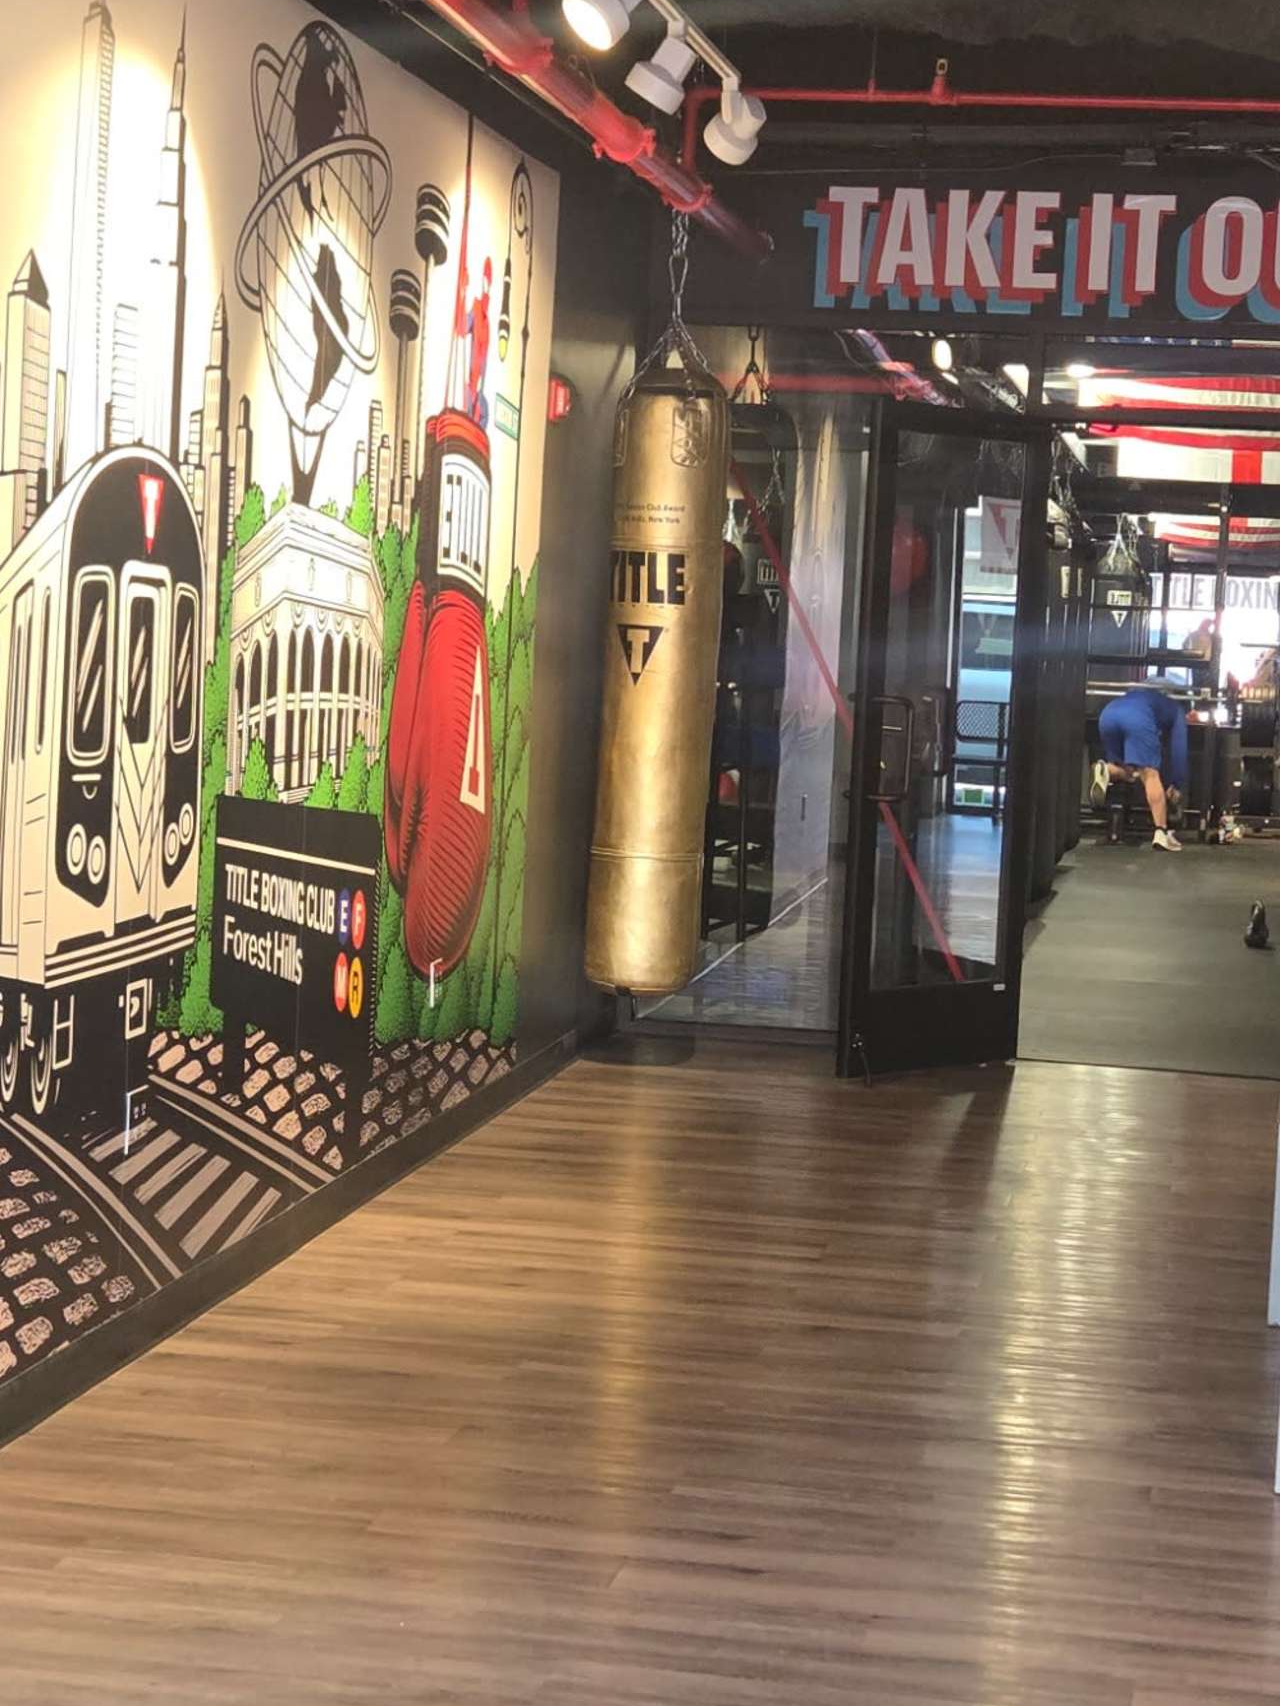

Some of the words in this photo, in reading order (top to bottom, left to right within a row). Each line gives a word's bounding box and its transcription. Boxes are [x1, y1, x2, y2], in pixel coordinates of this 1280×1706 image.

[828, 186, 1060, 290] TAKE
[1088, 193, 1177, 292] IT
[1151, 576, 1204, 607] TTLE
[225, 864, 259, 909] TITLE
[261, 873, 304, 925] BOXING
[306, 884, 336, 934] CLUB
[224, 915, 271, 971] Forest
[273, 931, 303, 985] Hills
